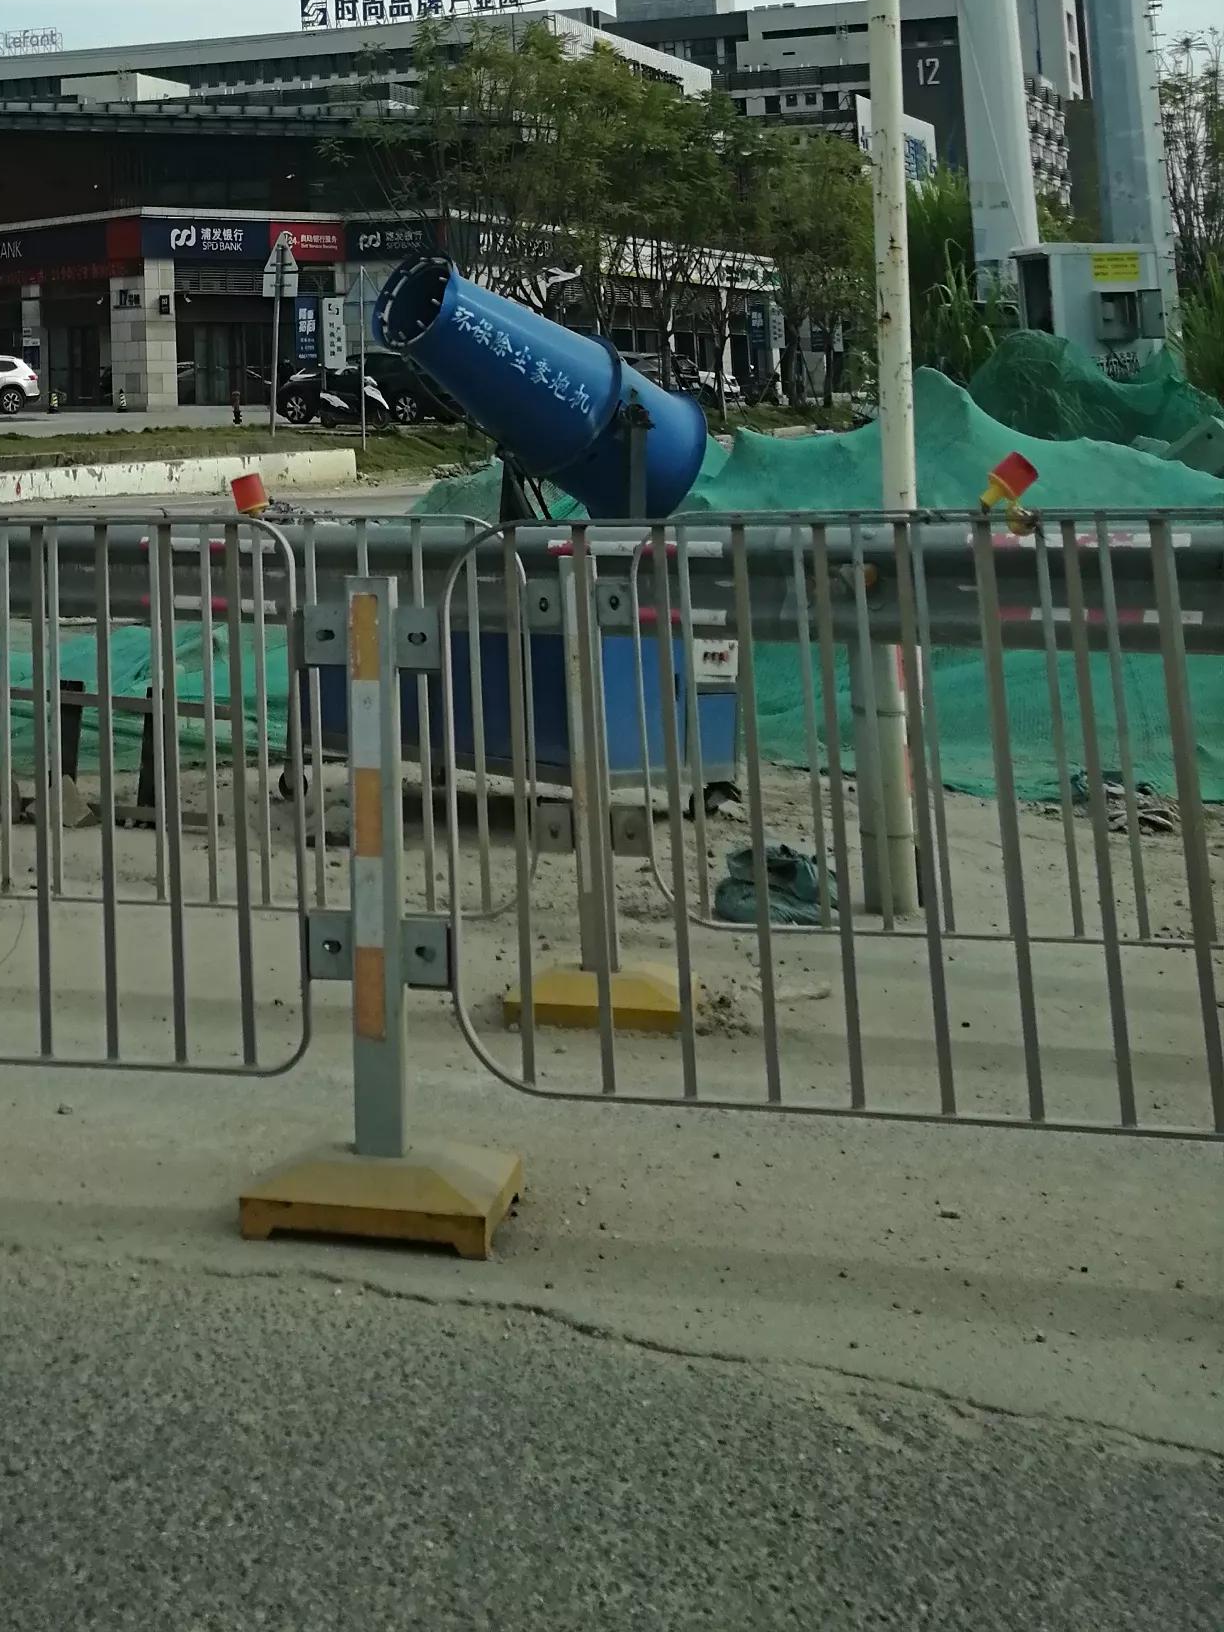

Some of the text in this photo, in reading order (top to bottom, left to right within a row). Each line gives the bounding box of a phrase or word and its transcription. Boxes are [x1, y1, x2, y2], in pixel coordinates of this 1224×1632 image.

[5, 29, 57, 49] Lefant
[916, 57, 941, 86] 12
[200, 227, 244, 242] 浦发银行
[202, 241, 243, 252] SPD BANK
[451, 305, 591, 414] 环保除尘雾炮机
